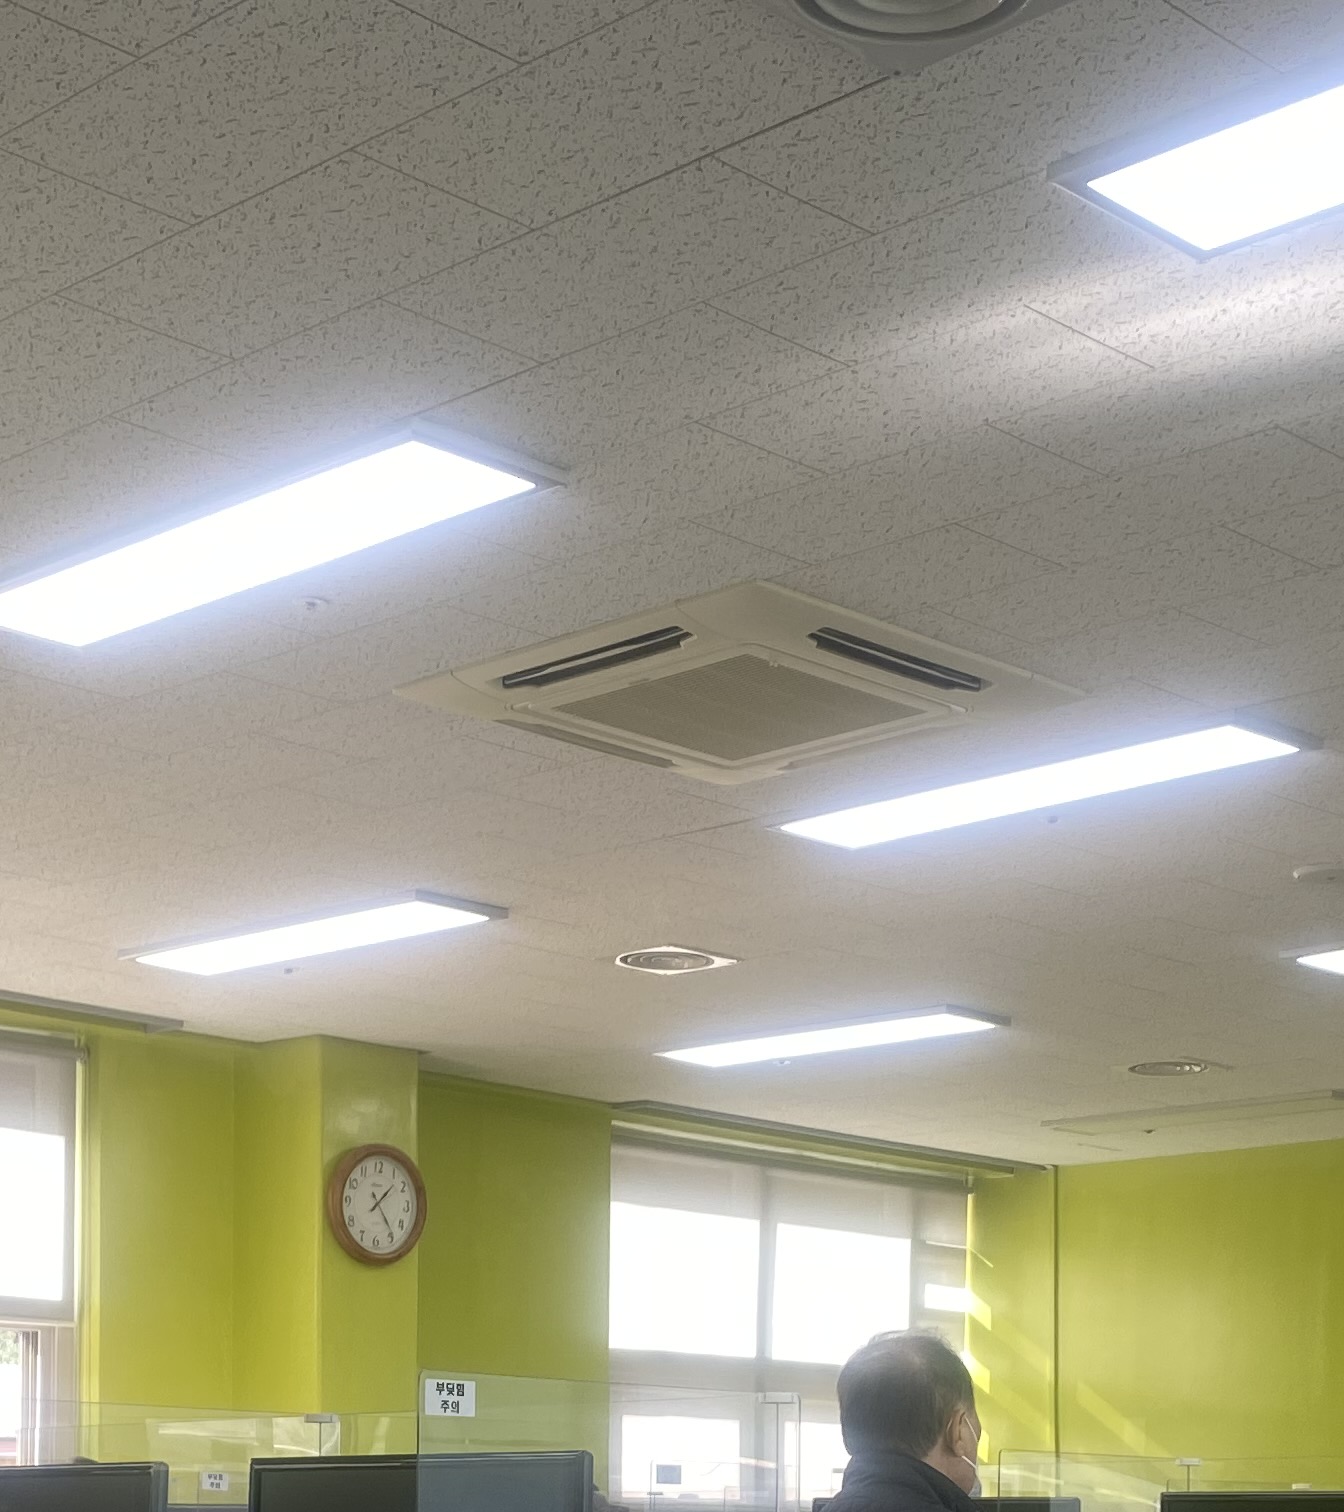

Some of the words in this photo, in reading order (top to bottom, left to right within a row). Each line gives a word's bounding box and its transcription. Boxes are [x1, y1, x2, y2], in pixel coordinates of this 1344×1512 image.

[360, 1166, 367, 1177] 11
[374, 1161, 383, 1173] 12
[348, 1177, 358, 1190] 10
[400, 1180, 406, 1193] 2
[345, 1195, 351, 1207] 9
[403, 1200, 410, 1213] 3
[348, 1215, 355, 1227] 8
[398, 1219, 404, 1231] 4
[359, 1230, 365, 1242] 7
[373, 1235, 380, 1247] 6
[387, 1232, 394, 1244] 5
[436, 1382, 464, 1396] 부딪힘
[441, 1400, 459, 1414] 주의
